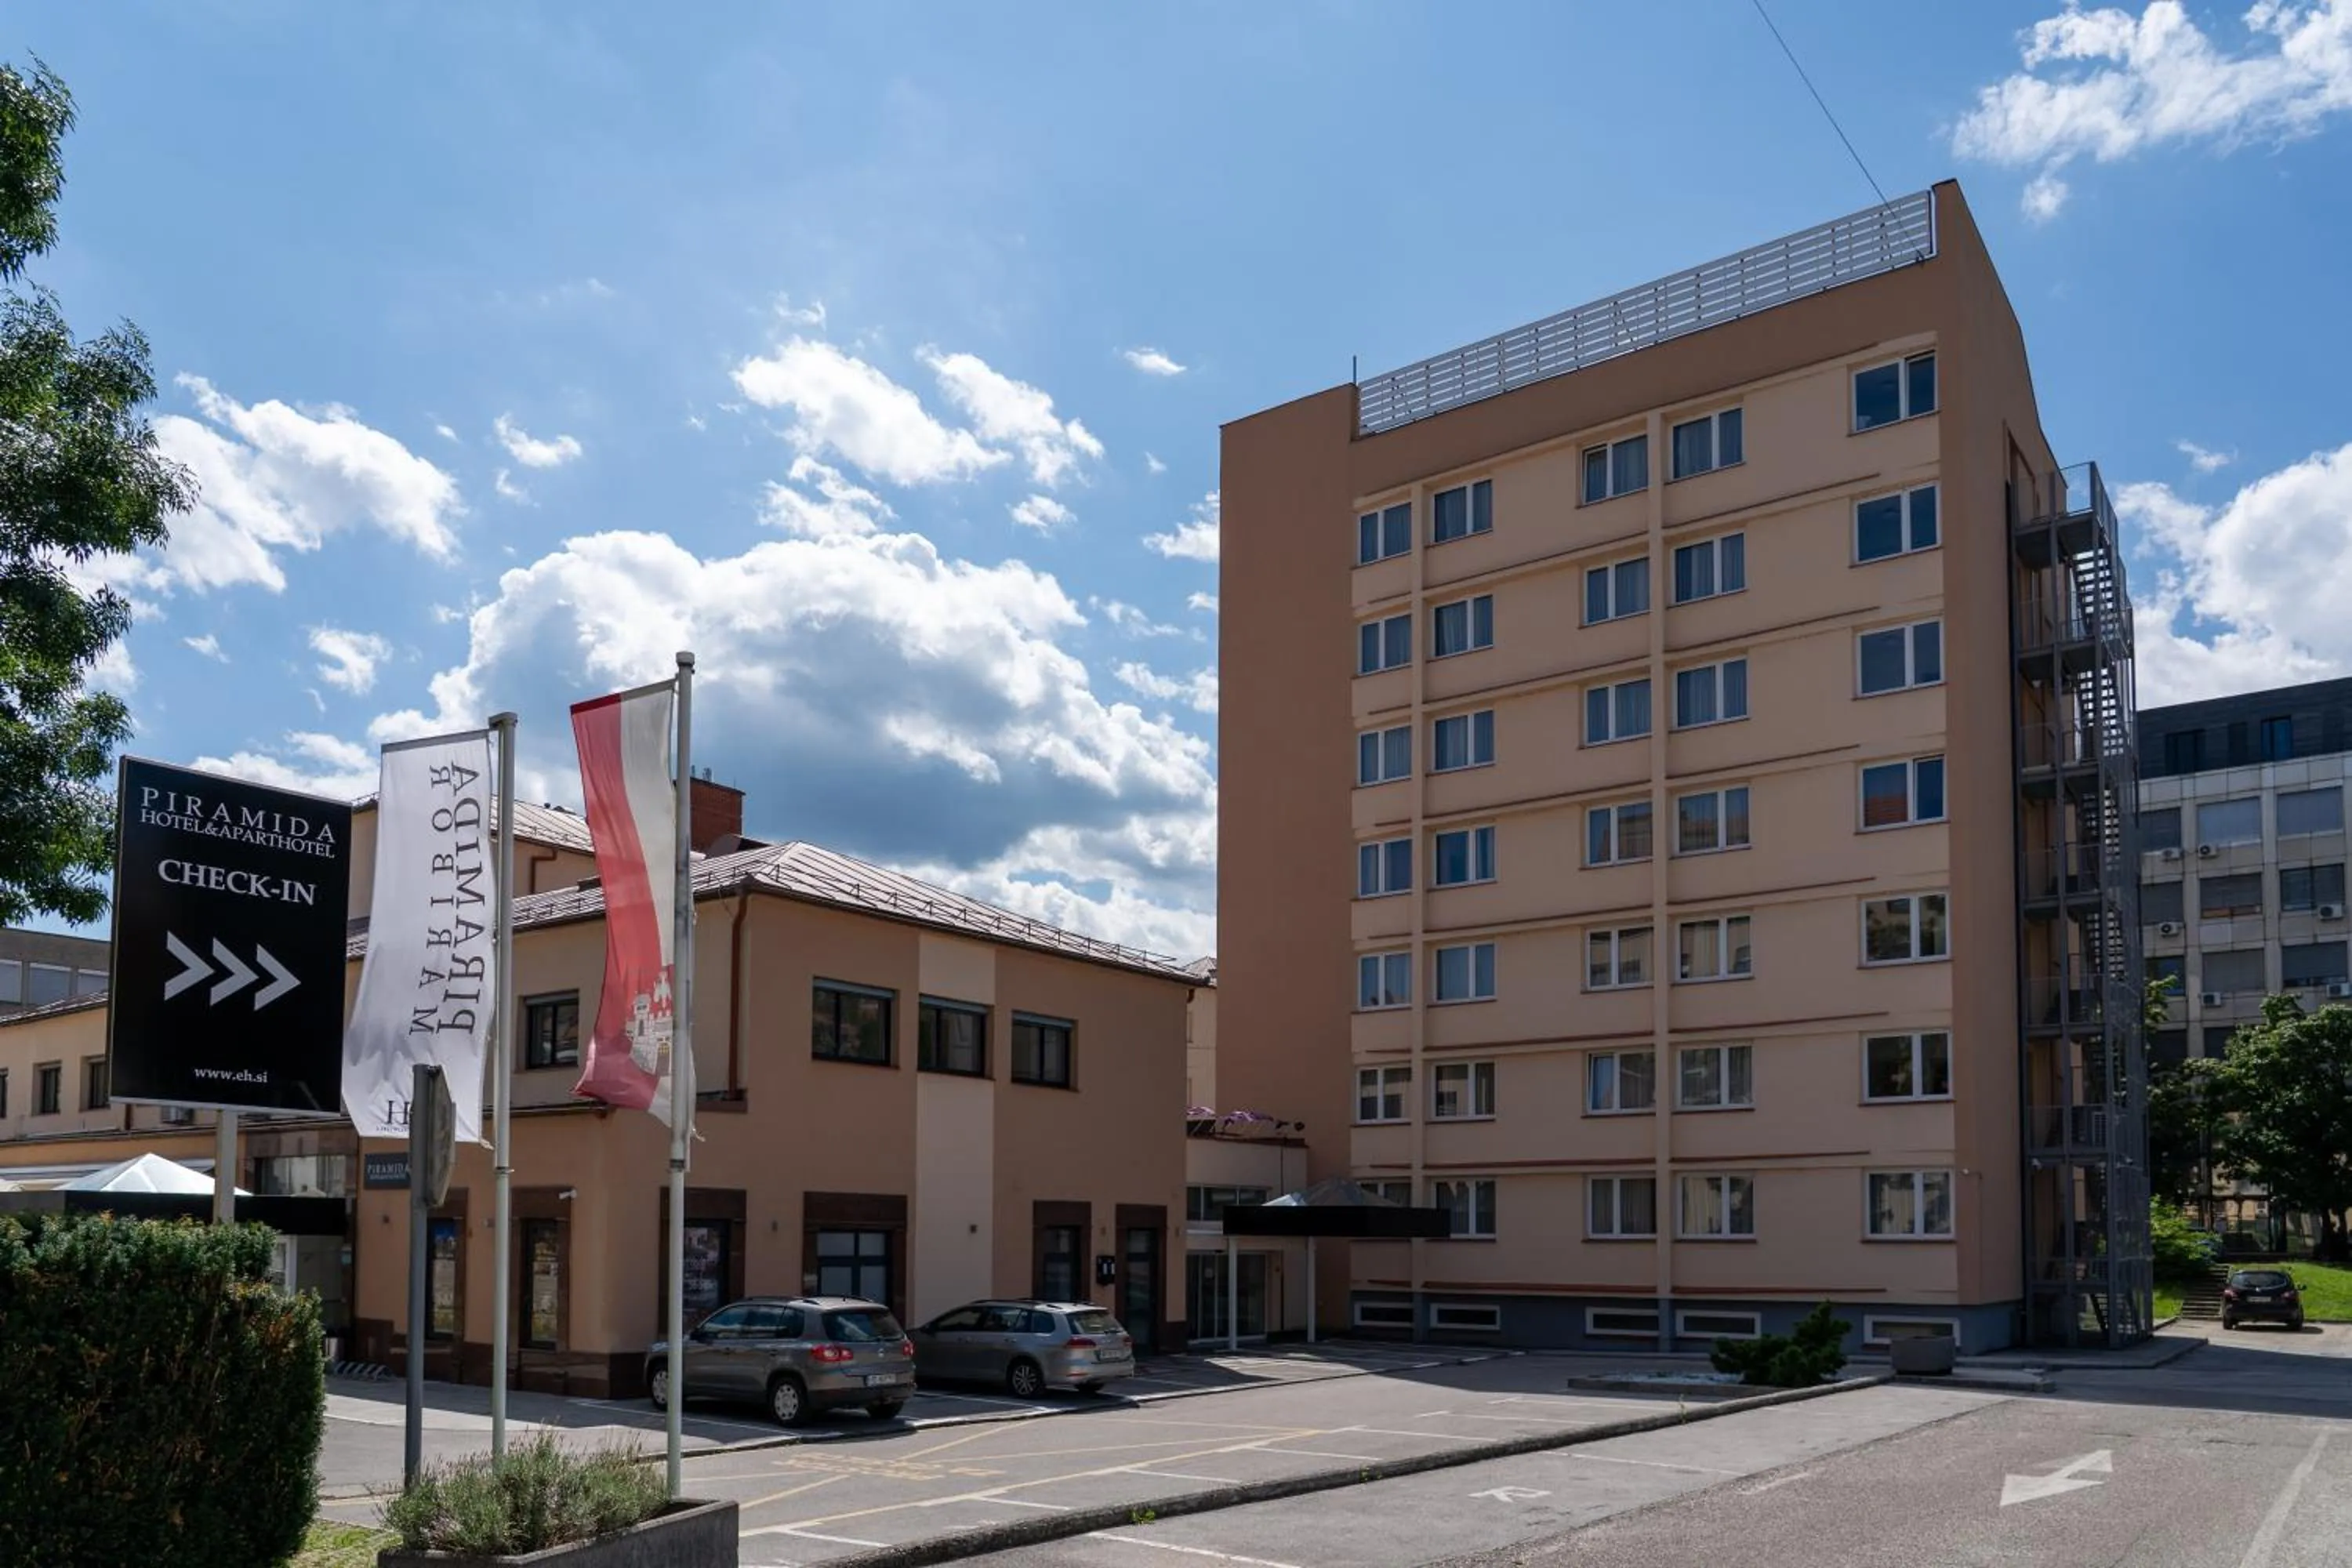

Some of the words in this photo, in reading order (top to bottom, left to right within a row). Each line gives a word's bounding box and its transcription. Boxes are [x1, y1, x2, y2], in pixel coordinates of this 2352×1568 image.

[140, 786, 336, 844] PIRAMIDA
[140, 808, 336, 858] HOTEL&APARTHOTEL
[158, 858, 317, 906] CHECK-IN
[194, 1068, 268, 1083] www.eh.si
